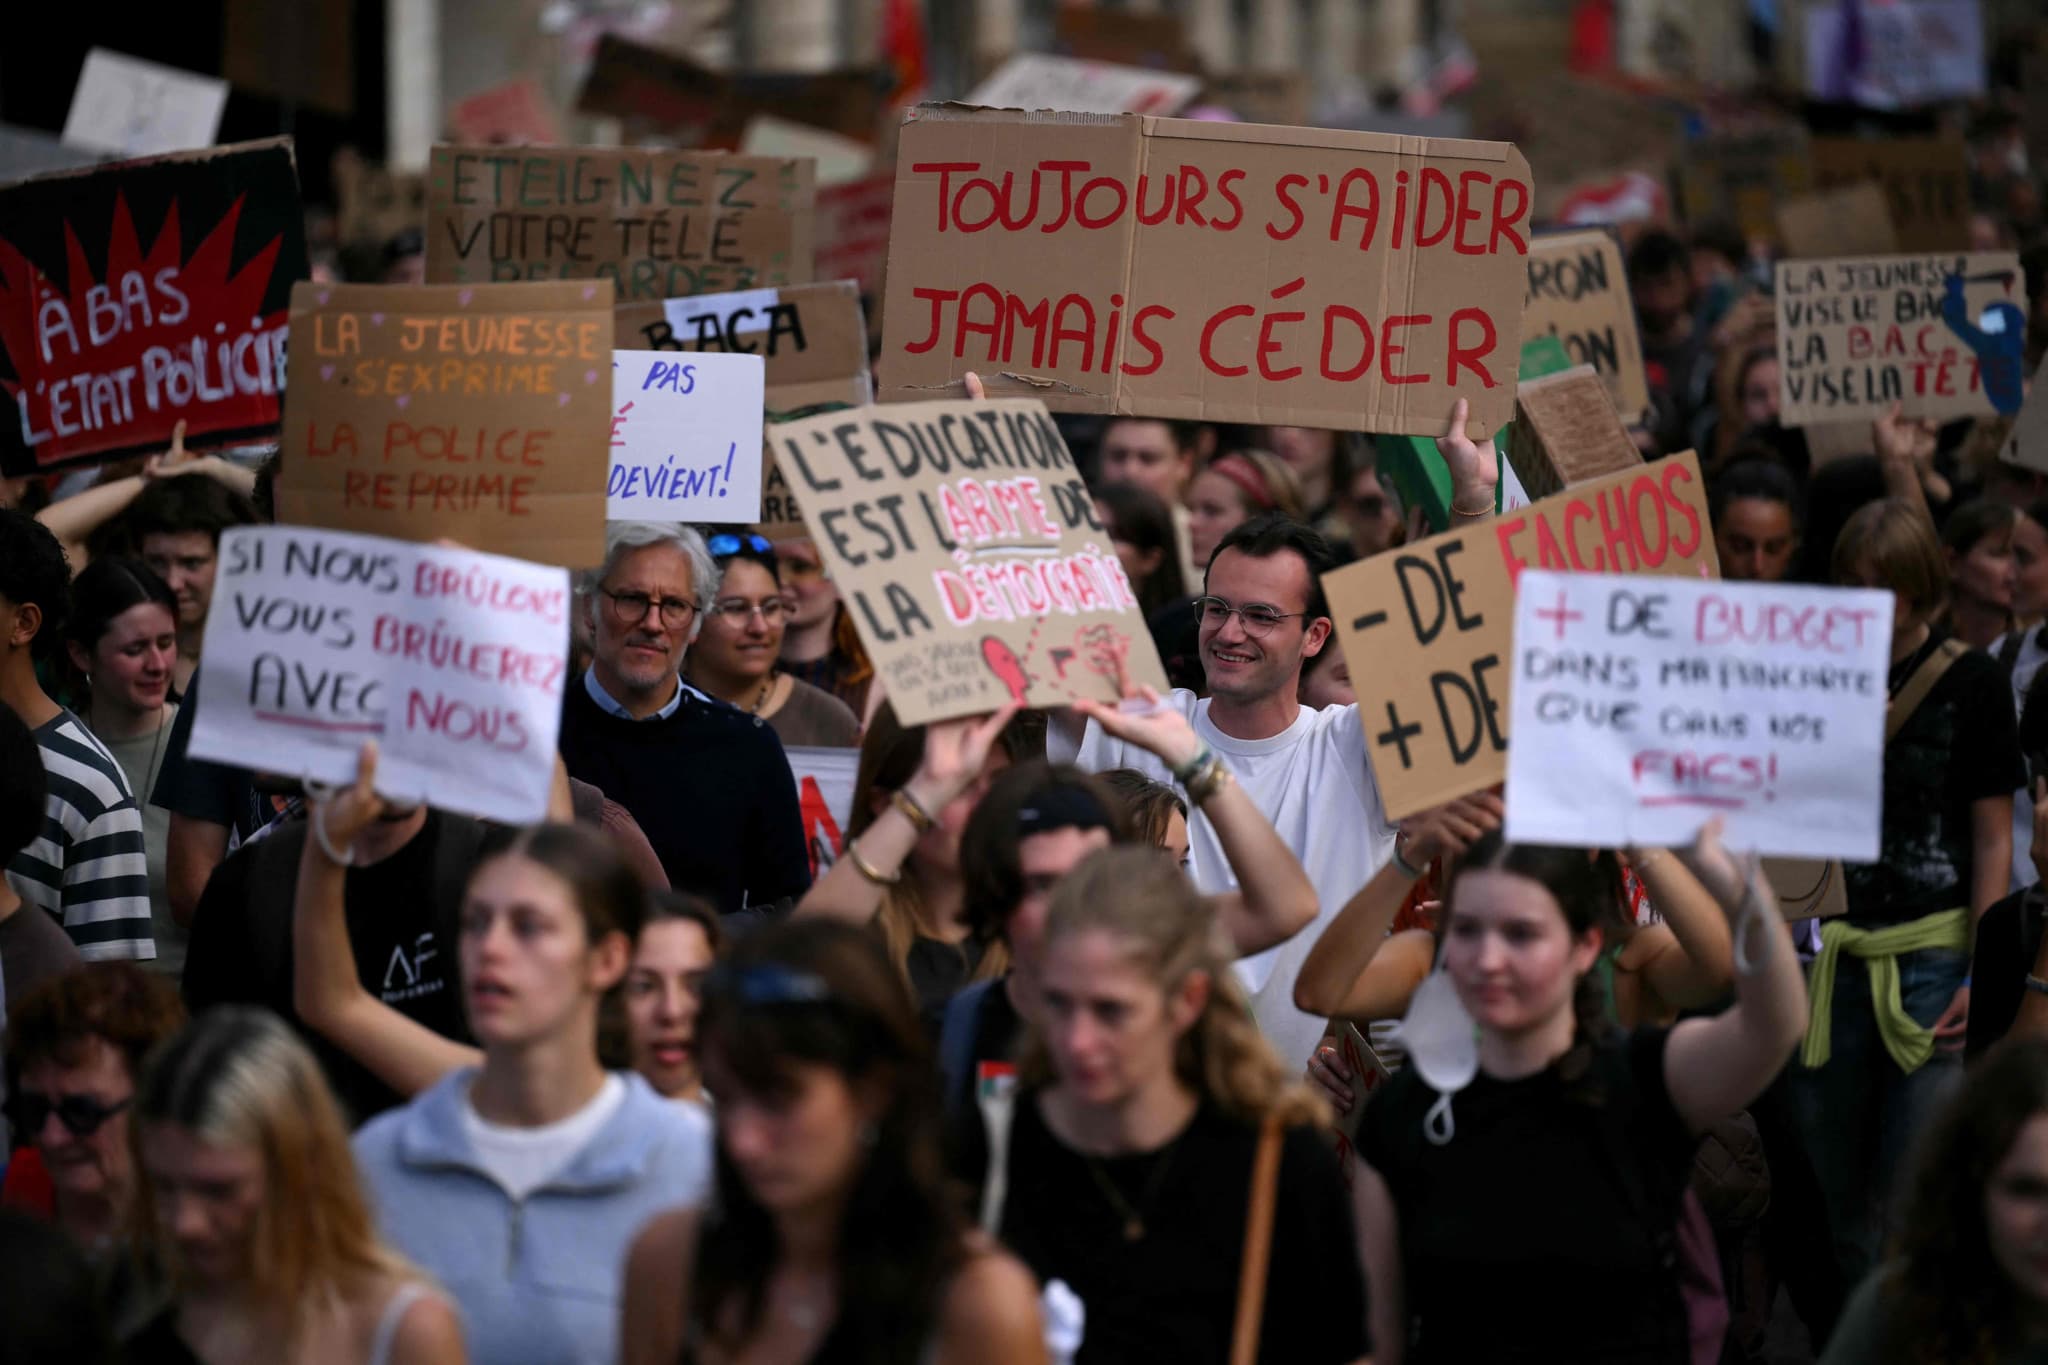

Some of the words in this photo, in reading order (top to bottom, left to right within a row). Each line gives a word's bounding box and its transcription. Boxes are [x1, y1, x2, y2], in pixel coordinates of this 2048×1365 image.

[912, 159, 1247, 234] TOUJOURS
[445, 213, 595, 263] VOTRE
[613, 208, 744, 264] TÉLÉ
[85, 267, 190, 347] BAS
[1783, 265, 1826, 295] LA
[313, 312, 361, 358] LA
[399, 317, 602, 361] JEUNESSE
[1199, 276, 1502, 389] CÉDER
[1786, 332, 1828, 369] LA
[354, 357, 557, 397] S'EXPRIME
[642, 361, 697, 394] PAS
[1786, 366, 1859, 408] VISE
[1866, 364, 1903, 404] LA
[17, 365, 136, 447] L'ETAT
[306, 420, 359, 459] LA
[383, 420, 556, 469] POLICE
[345, 469, 538, 517] REPRIME
[819, 491, 919, 568] EST
[1051, 479, 1105, 532] DE
[225, 535, 263, 577] SI
[284, 538, 400, 593] NOUS
[1394, 538, 1483, 646] DE
[1496, 462, 1701, 592] FACHOS
[234, 592, 356, 649] VOUS
[853, 578, 935, 643] LA
[1606, 589, 1673, 639] DE
[1693, 593, 1878, 654] BUDGET
[1523, 647, 1639, 691] DANS
[1659, 655, 1710, 686] MA
[248, 651, 388, 718] AVEC
[406, 688, 530, 753] NOUS
[1430, 653, 1508, 766] DE
[1535, 690, 1640, 733] QUE
[1658, 705, 1750, 738] DANS
[1632, 748, 1779, 803] FACS!
